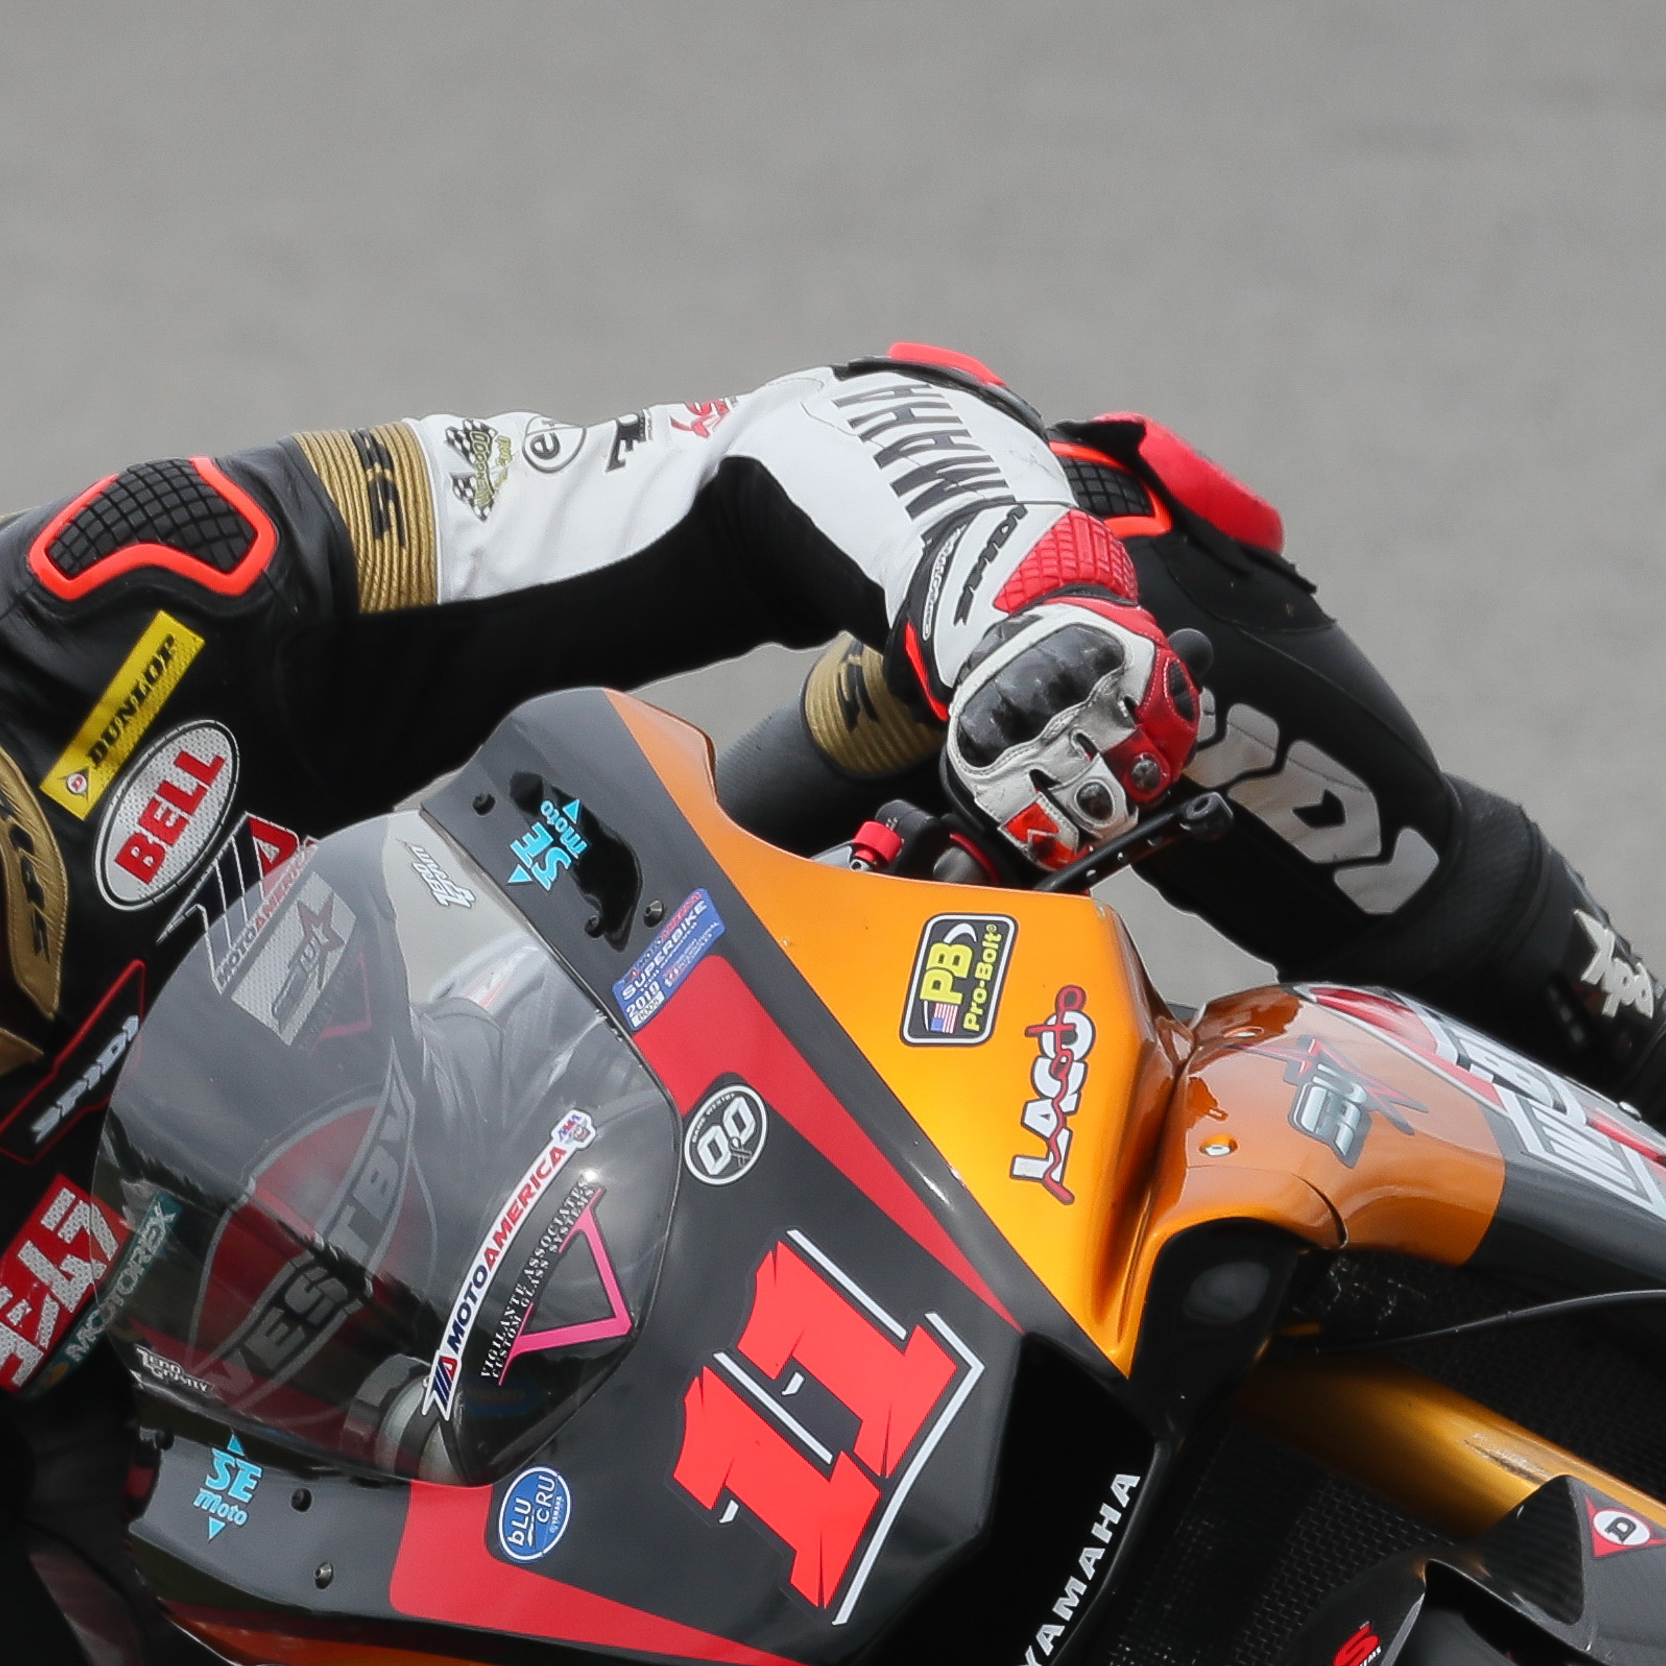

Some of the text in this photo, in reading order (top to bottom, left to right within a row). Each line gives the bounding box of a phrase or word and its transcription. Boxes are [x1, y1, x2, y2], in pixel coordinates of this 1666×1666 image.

[88, 632, 179, 769] DUNLOP
[114, 748, 227, 885] BELL
[510, 821, 572, 891] SE
[622, 900, 708, 1000] SUPERBIKE
[920, 942, 973, 1005] PB
[963, 928, 1001, 1033] Pro-Bolt
[33, 1015, 140, 1143] SPIDI
[64, 1203, 178, 1363] MOTOREX
[447, 1146, 567, 1354] MOTOAMERICA
[481, 1179, 589, 1379] VIGILANTE ASSOCIATES
[491, 1187, 596, 1380] CUSTOM GLASS SYSTEMS
[205, 1447, 263, 1504] SE
[673, 1240, 959, 1610] 11
